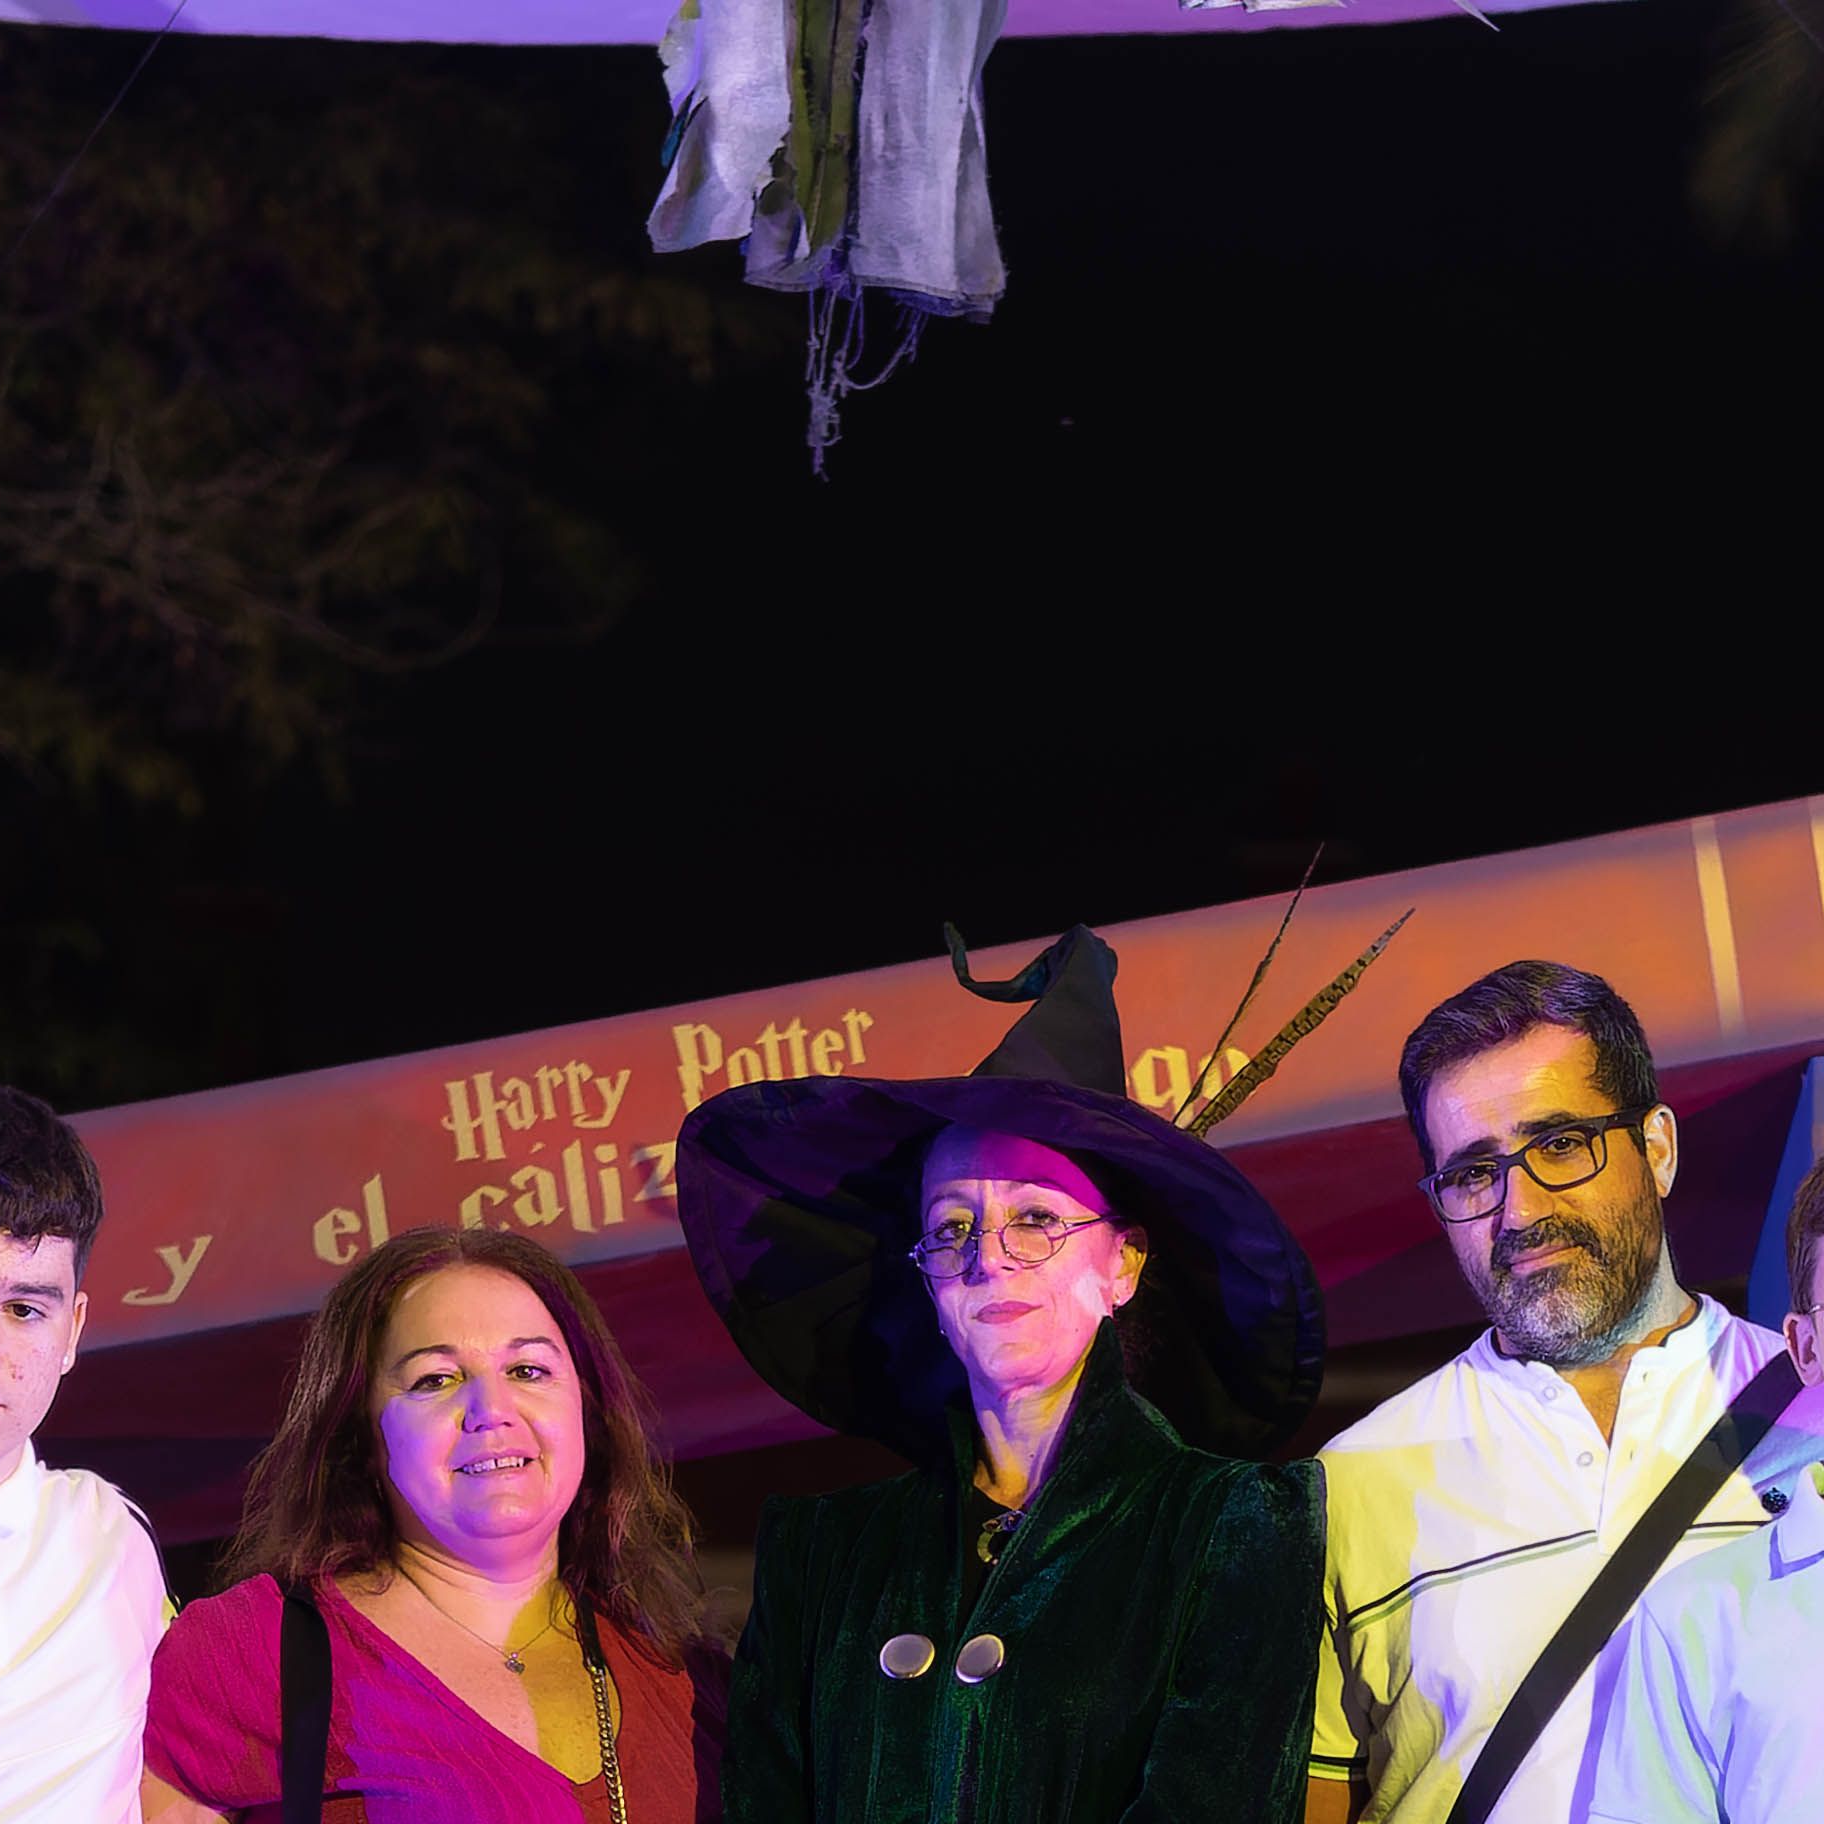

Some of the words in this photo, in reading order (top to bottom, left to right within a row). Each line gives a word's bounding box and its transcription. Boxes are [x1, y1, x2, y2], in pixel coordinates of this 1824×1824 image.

[440, 1058, 632, 1163] Harry
[672, 1008, 875, 1113] Potter
[122, 1235, 212, 1306] y
[313, 1172, 390, 1266] el
[459, 1138, 678, 1233] cáliz
